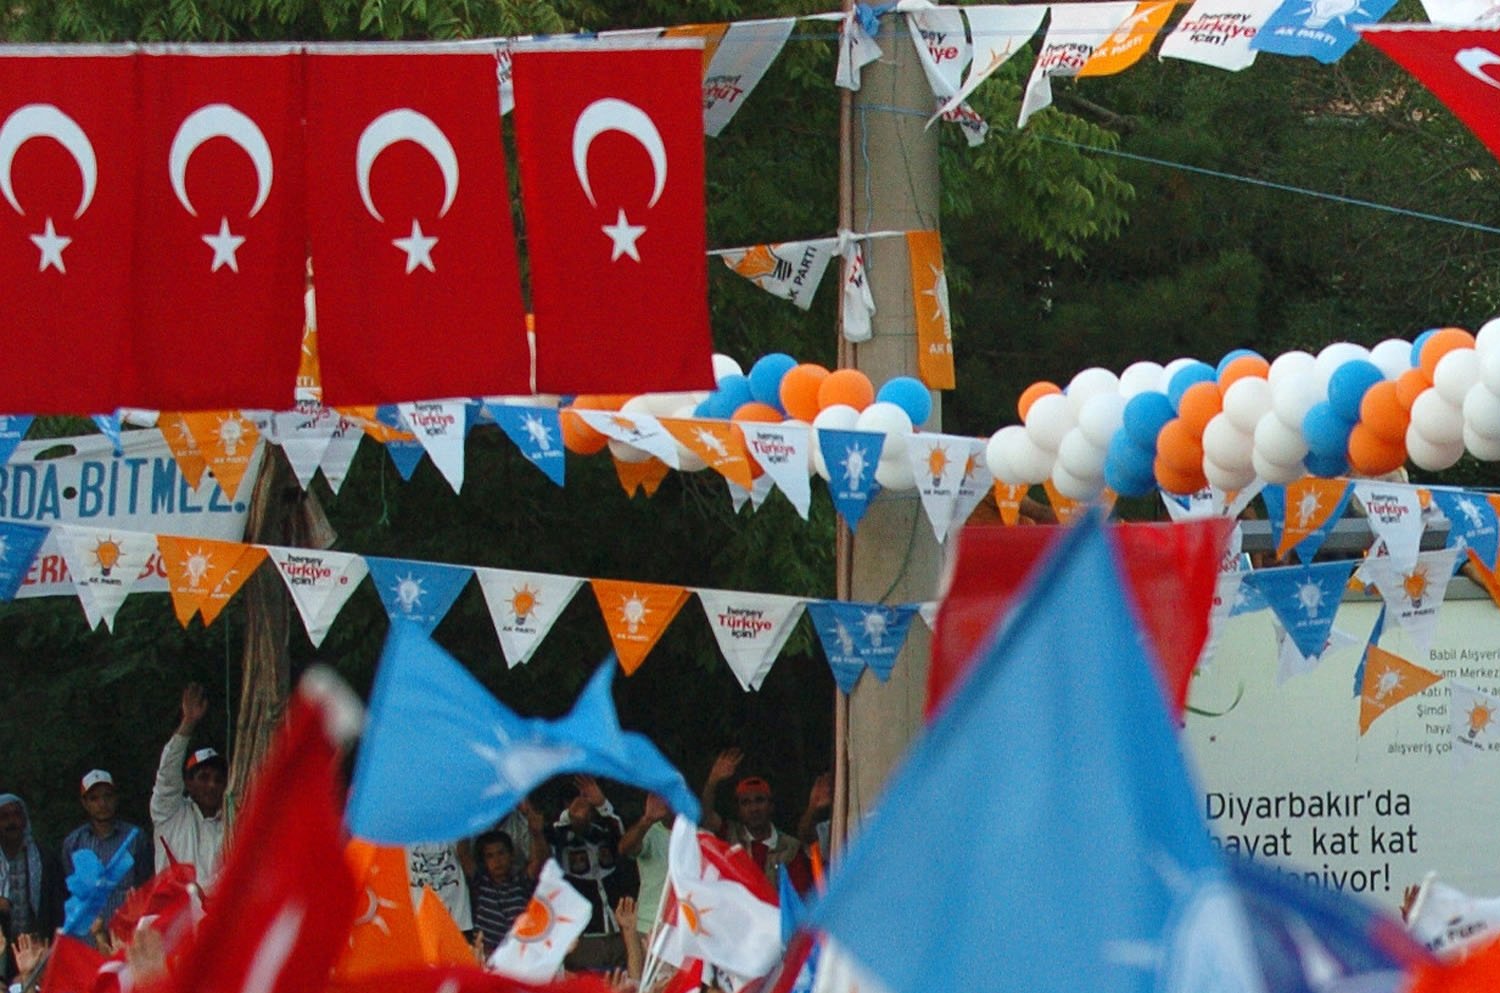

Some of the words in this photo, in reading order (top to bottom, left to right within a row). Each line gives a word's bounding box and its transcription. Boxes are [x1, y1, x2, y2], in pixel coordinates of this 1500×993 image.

[1181, 20, 1257, 38] Türkiye
[1274, 26, 1295, 36] AK
[410, 413, 455, 427] Türkiye
[280, 561, 331, 579] Türkiye
[718, 614, 772, 632] Türkiye
[1426, 724, 1451, 735] hay
[1206, 789, 1410, 826] Diyarbakır'da
[1313, 826, 1359, 855] kat
[1371, 824, 1418, 854] kat
